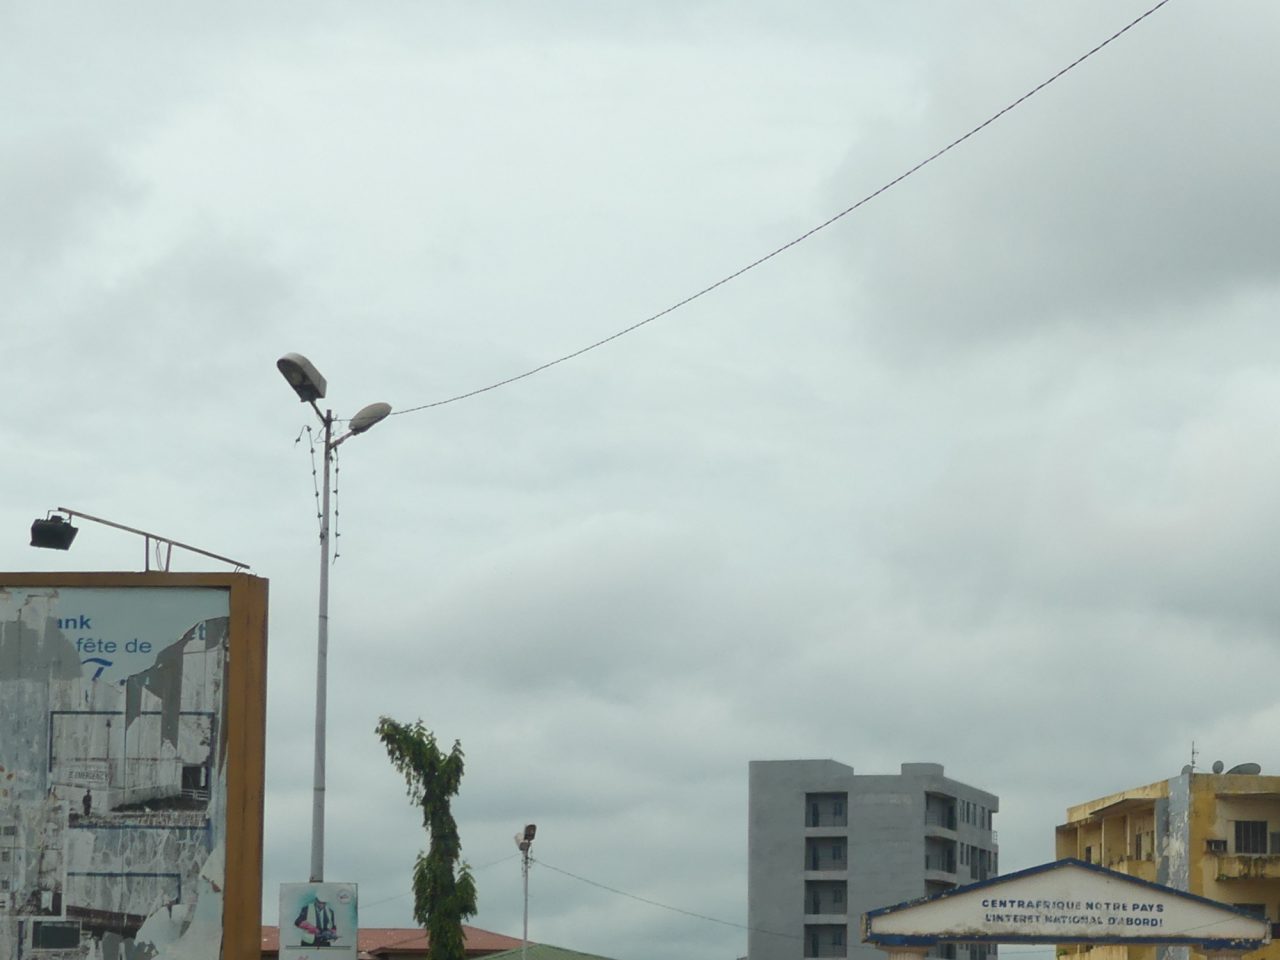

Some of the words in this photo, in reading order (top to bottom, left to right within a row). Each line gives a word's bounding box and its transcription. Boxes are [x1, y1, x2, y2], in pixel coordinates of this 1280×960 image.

[76, 638, 117, 653] fête
[125, 638, 152, 653] de
[982, 900, 1081, 911] CENTRAFRIQUE
[1085, 902, 1128, 911] NOTRE
[1132, 903, 1164, 912] PAYS
[1045, 915, 1104, 925] NATIONAL
[1108, 917, 1164, 927] D'ABORD!
